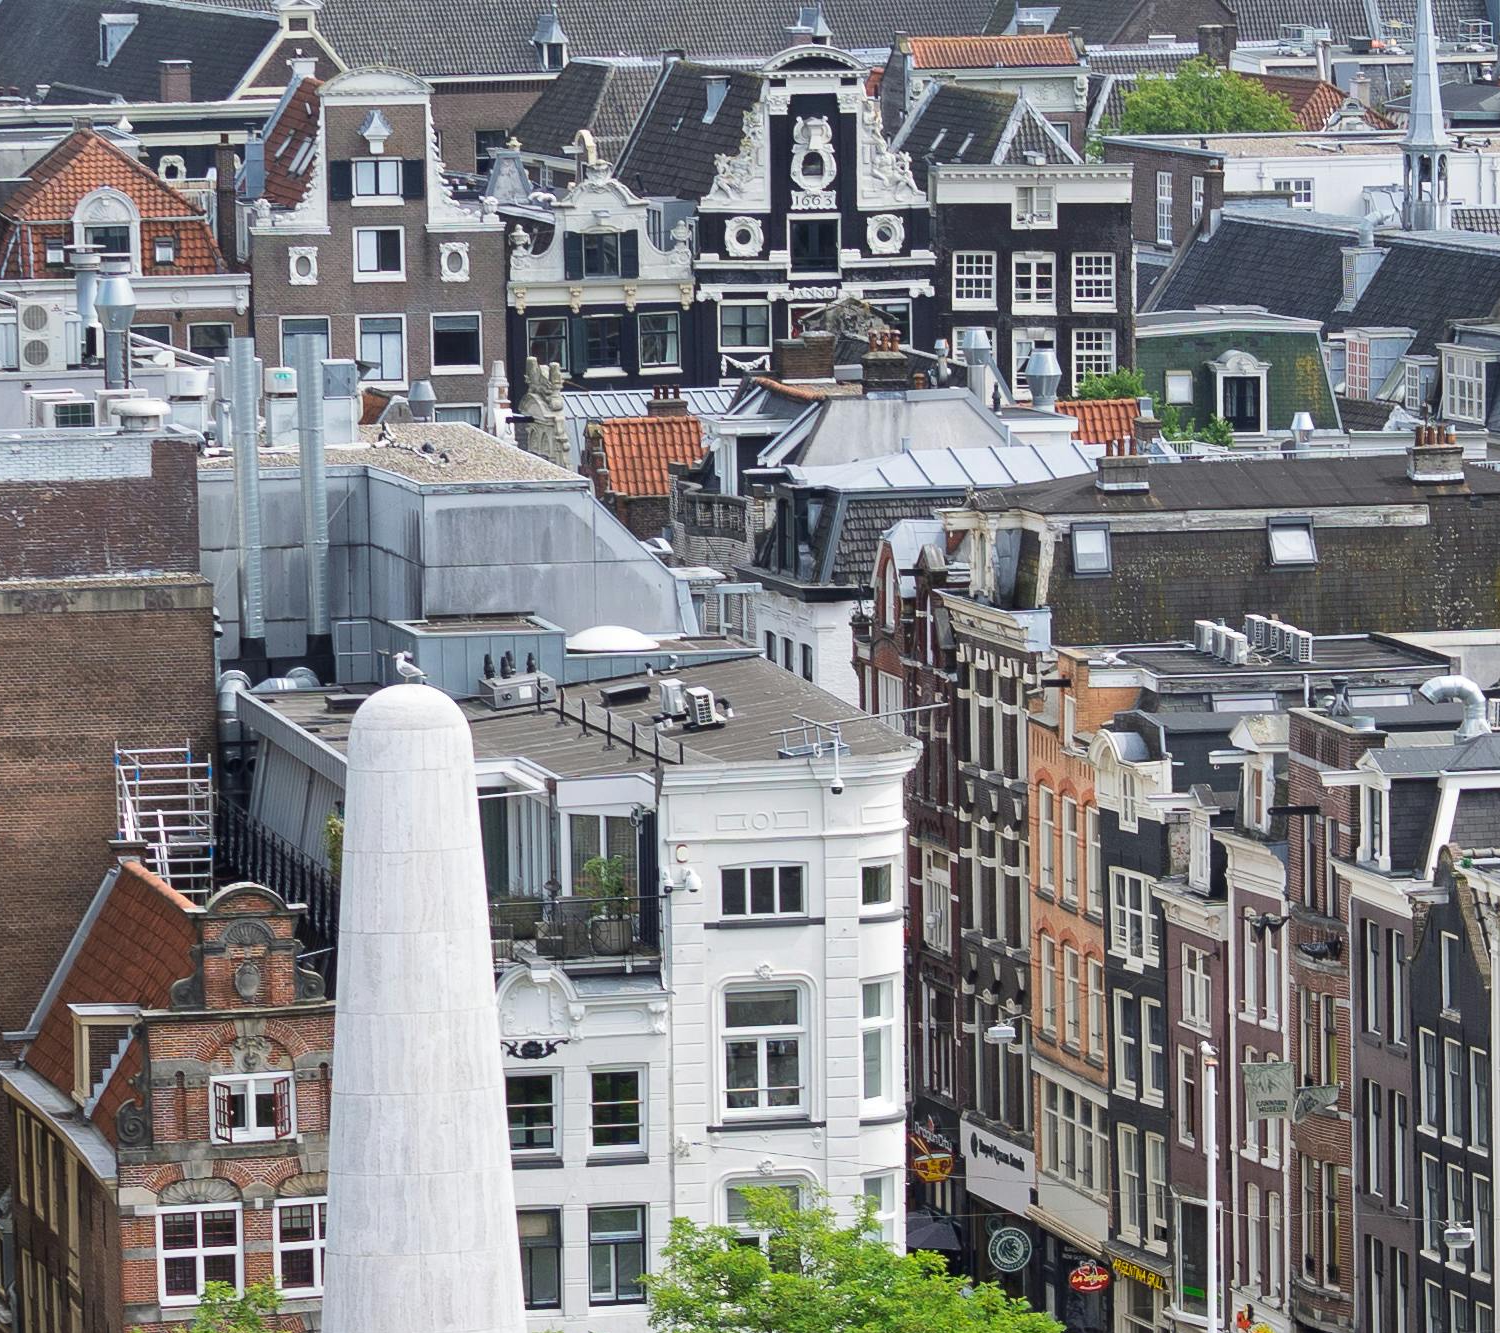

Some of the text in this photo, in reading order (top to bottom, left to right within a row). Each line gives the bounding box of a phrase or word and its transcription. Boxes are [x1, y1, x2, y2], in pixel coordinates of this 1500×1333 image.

[796, 287, 835, 299] ANNO
[1112, 1258, 1147, 1281] ARGENTINA
[1147, 1273, 1164, 1289] GRILL
